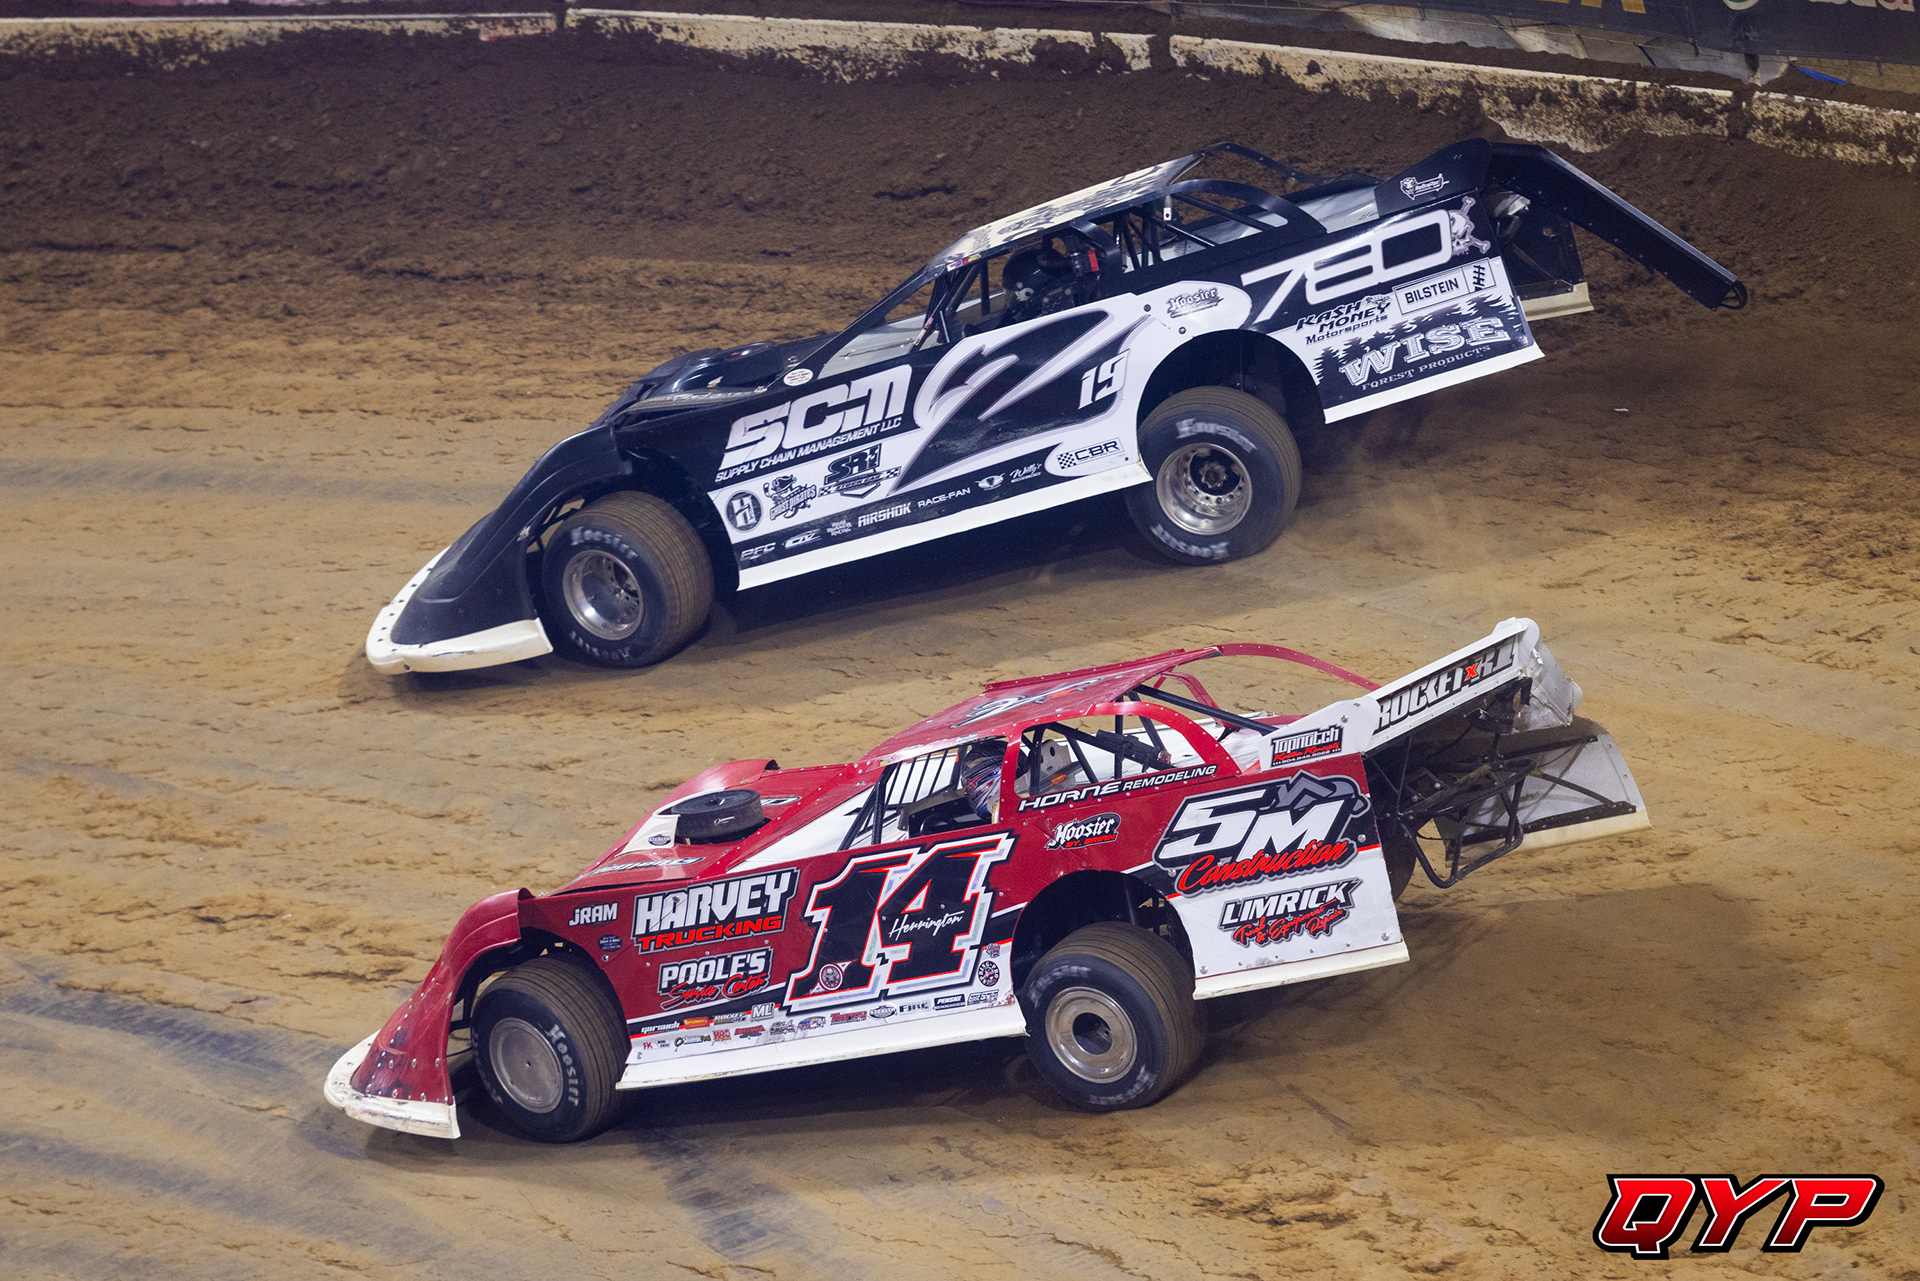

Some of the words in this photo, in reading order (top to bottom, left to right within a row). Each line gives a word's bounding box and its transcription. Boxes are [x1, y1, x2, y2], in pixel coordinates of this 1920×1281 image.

[1167, 288, 1218, 313] Hoosier
[1405, 278, 1459, 304] BILSTEIN
[1296, 301, 1362, 331] KASH
[1306, 315, 1387, 345] Motorsports
[1319, 302, 1391, 333] MONEY
[1339, 317, 1511, 387] WISE
[1362, 369, 1414, 391] FOREST
[1418, 345, 1491, 372] PRODUCTS
[1078, 348, 1130, 410] 19
[719, 364, 912, 471] SCM
[715, 462, 761, 483] SUPPLY
[760, 450, 795, 470] CHAIN
[797, 427, 877, 459] MANAGEMENT
[880, 417, 902, 433] LLC
[1074, 440, 1119, 461] CBR
[918, 487, 971, 508] RACE-FAN
[857, 502, 911, 528] AIRSHOK
[1273, 728, 1340, 755] Topnotch
[1019, 780, 1122, 812] HORNE
[1122, 764, 1217, 791] REMODELING
[1047, 816, 1115, 846] Hoosier
[1084, 833, 1116, 845] BRIAN
[1159, 789, 1345, 862] 5M
[1178, 840, 1349, 890] Construction
[634, 872, 791, 935] HARVEY
[787, 836, 1006, 1003] 14
[1222, 881, 1348, 925] LIMRICK
[638, 915, 783, 949] TRUCKING
[889, 910, 965, 941] Herrington
[1233, 916, 1266, 944] Truck
[1269, 899, 1337, 940] Equipment
[1305, 909, 1344, 934] Repair
[661, 951, 767, 989] POOLE'S
[662, 982, 716, 1008] Service
[722, 973, 767, 996] Center
[752, 1004, 772, 1018] ML
